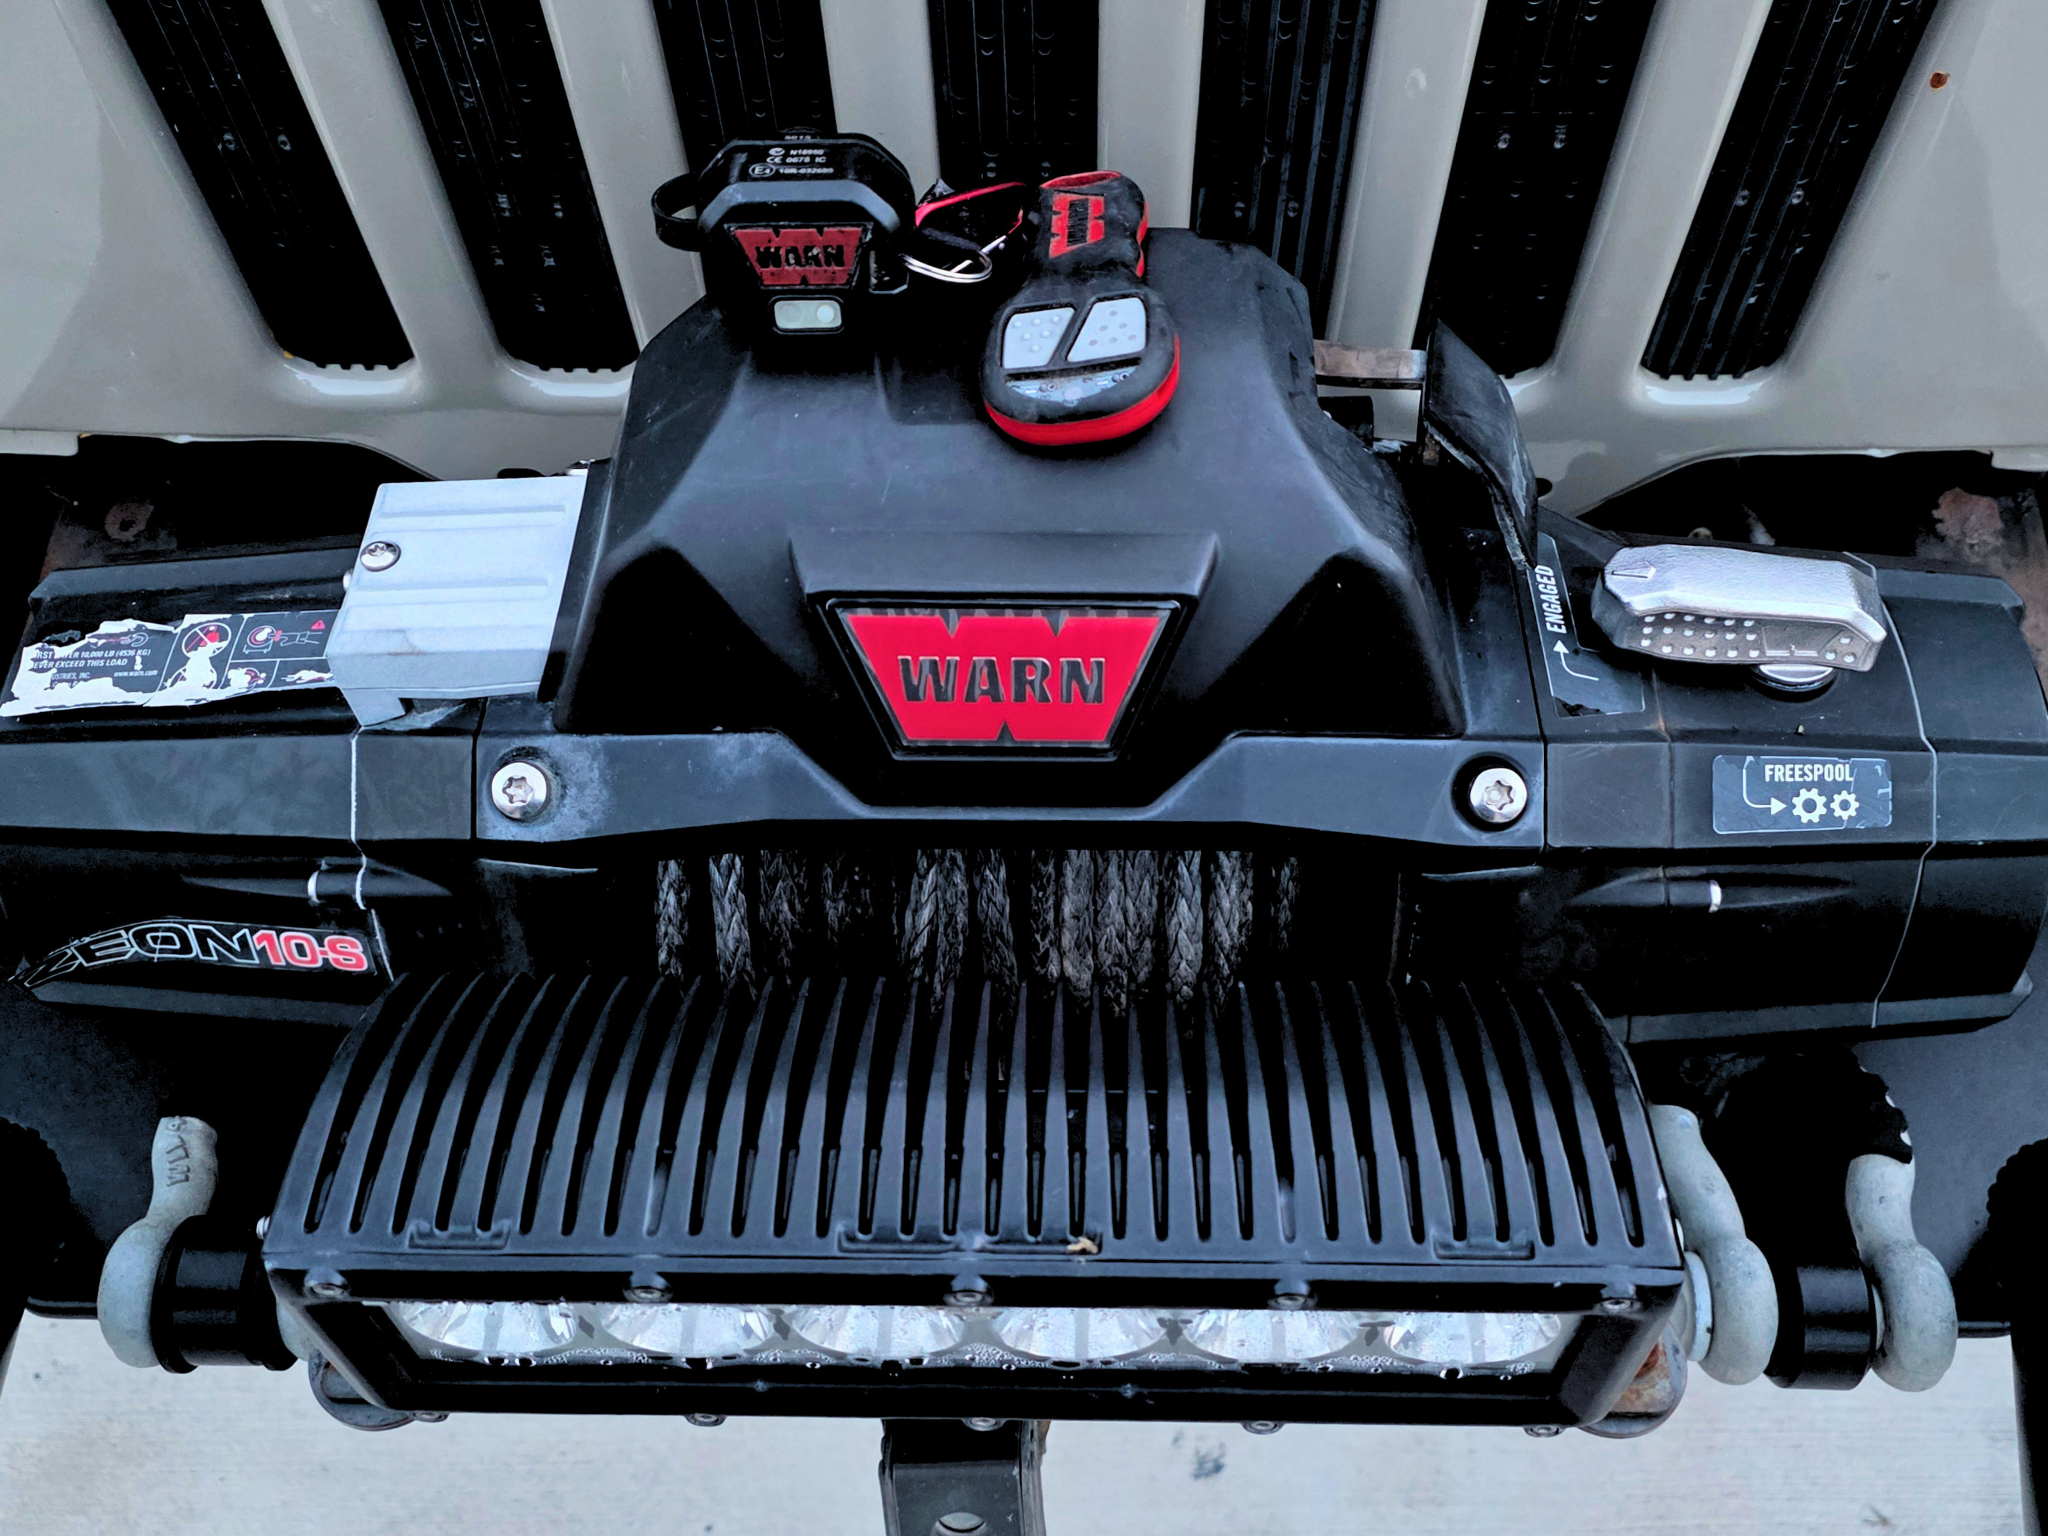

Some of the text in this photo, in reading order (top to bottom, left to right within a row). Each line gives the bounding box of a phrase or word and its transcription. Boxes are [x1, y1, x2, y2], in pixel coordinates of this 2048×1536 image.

[755, 245, 845, 268] WARN
[1534, 565, 1567, 634] ENGAGED
[33, 658, 128, 669] EVER EXCEED THIS LOAD
[104, 649, 115, 657] LB
[898, 656, 1105, 704] WARN
[1764, 763, 1854, 782] FREESPOOL
